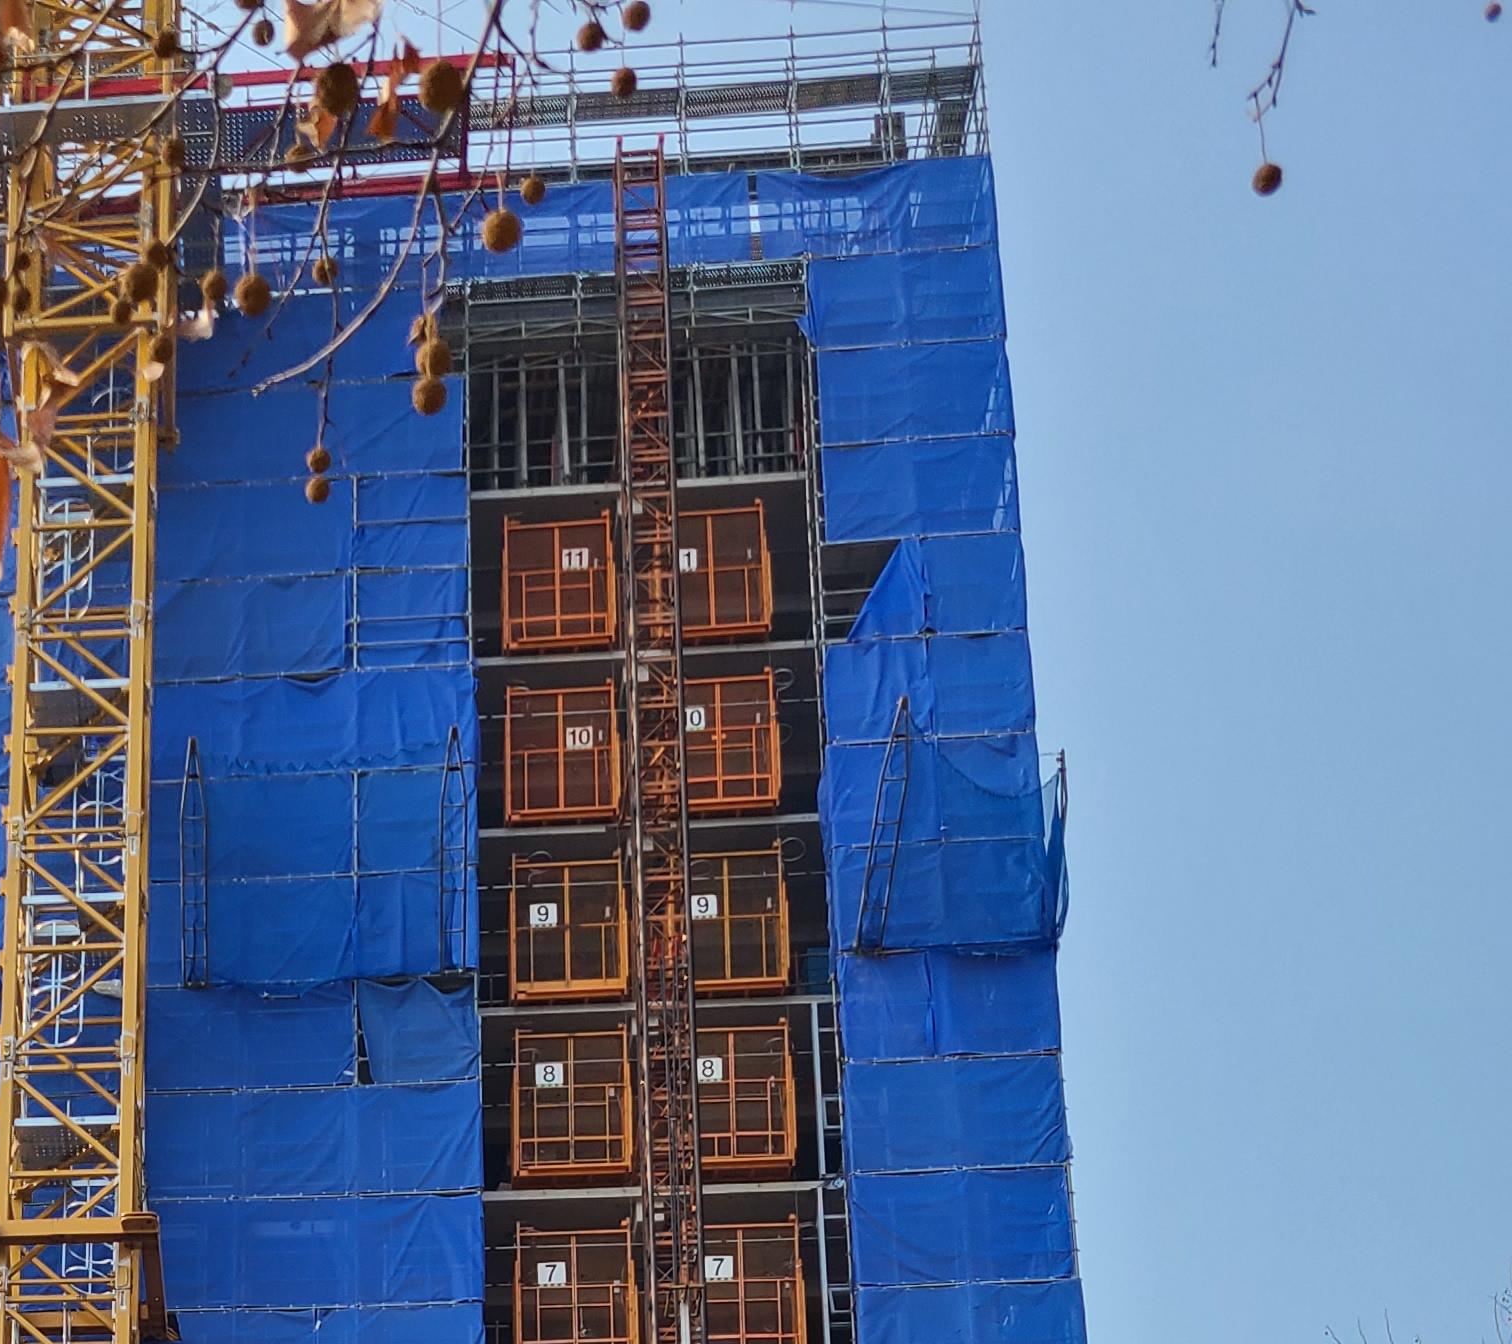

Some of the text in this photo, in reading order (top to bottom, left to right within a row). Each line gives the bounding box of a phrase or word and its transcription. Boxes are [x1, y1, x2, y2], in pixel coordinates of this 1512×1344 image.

[564, 552, 584, 566] 11
[569, 728, 590, 745] 10
[696, 898, 709, 914] 9
[537, 907, 549, 922] 9
[543, 1066, 555, 1082] 8
[702, 1061, 714, 1078] 8
[544, 1265, 557, 1282] 7
[712, 1259, 725, 1276] 7
